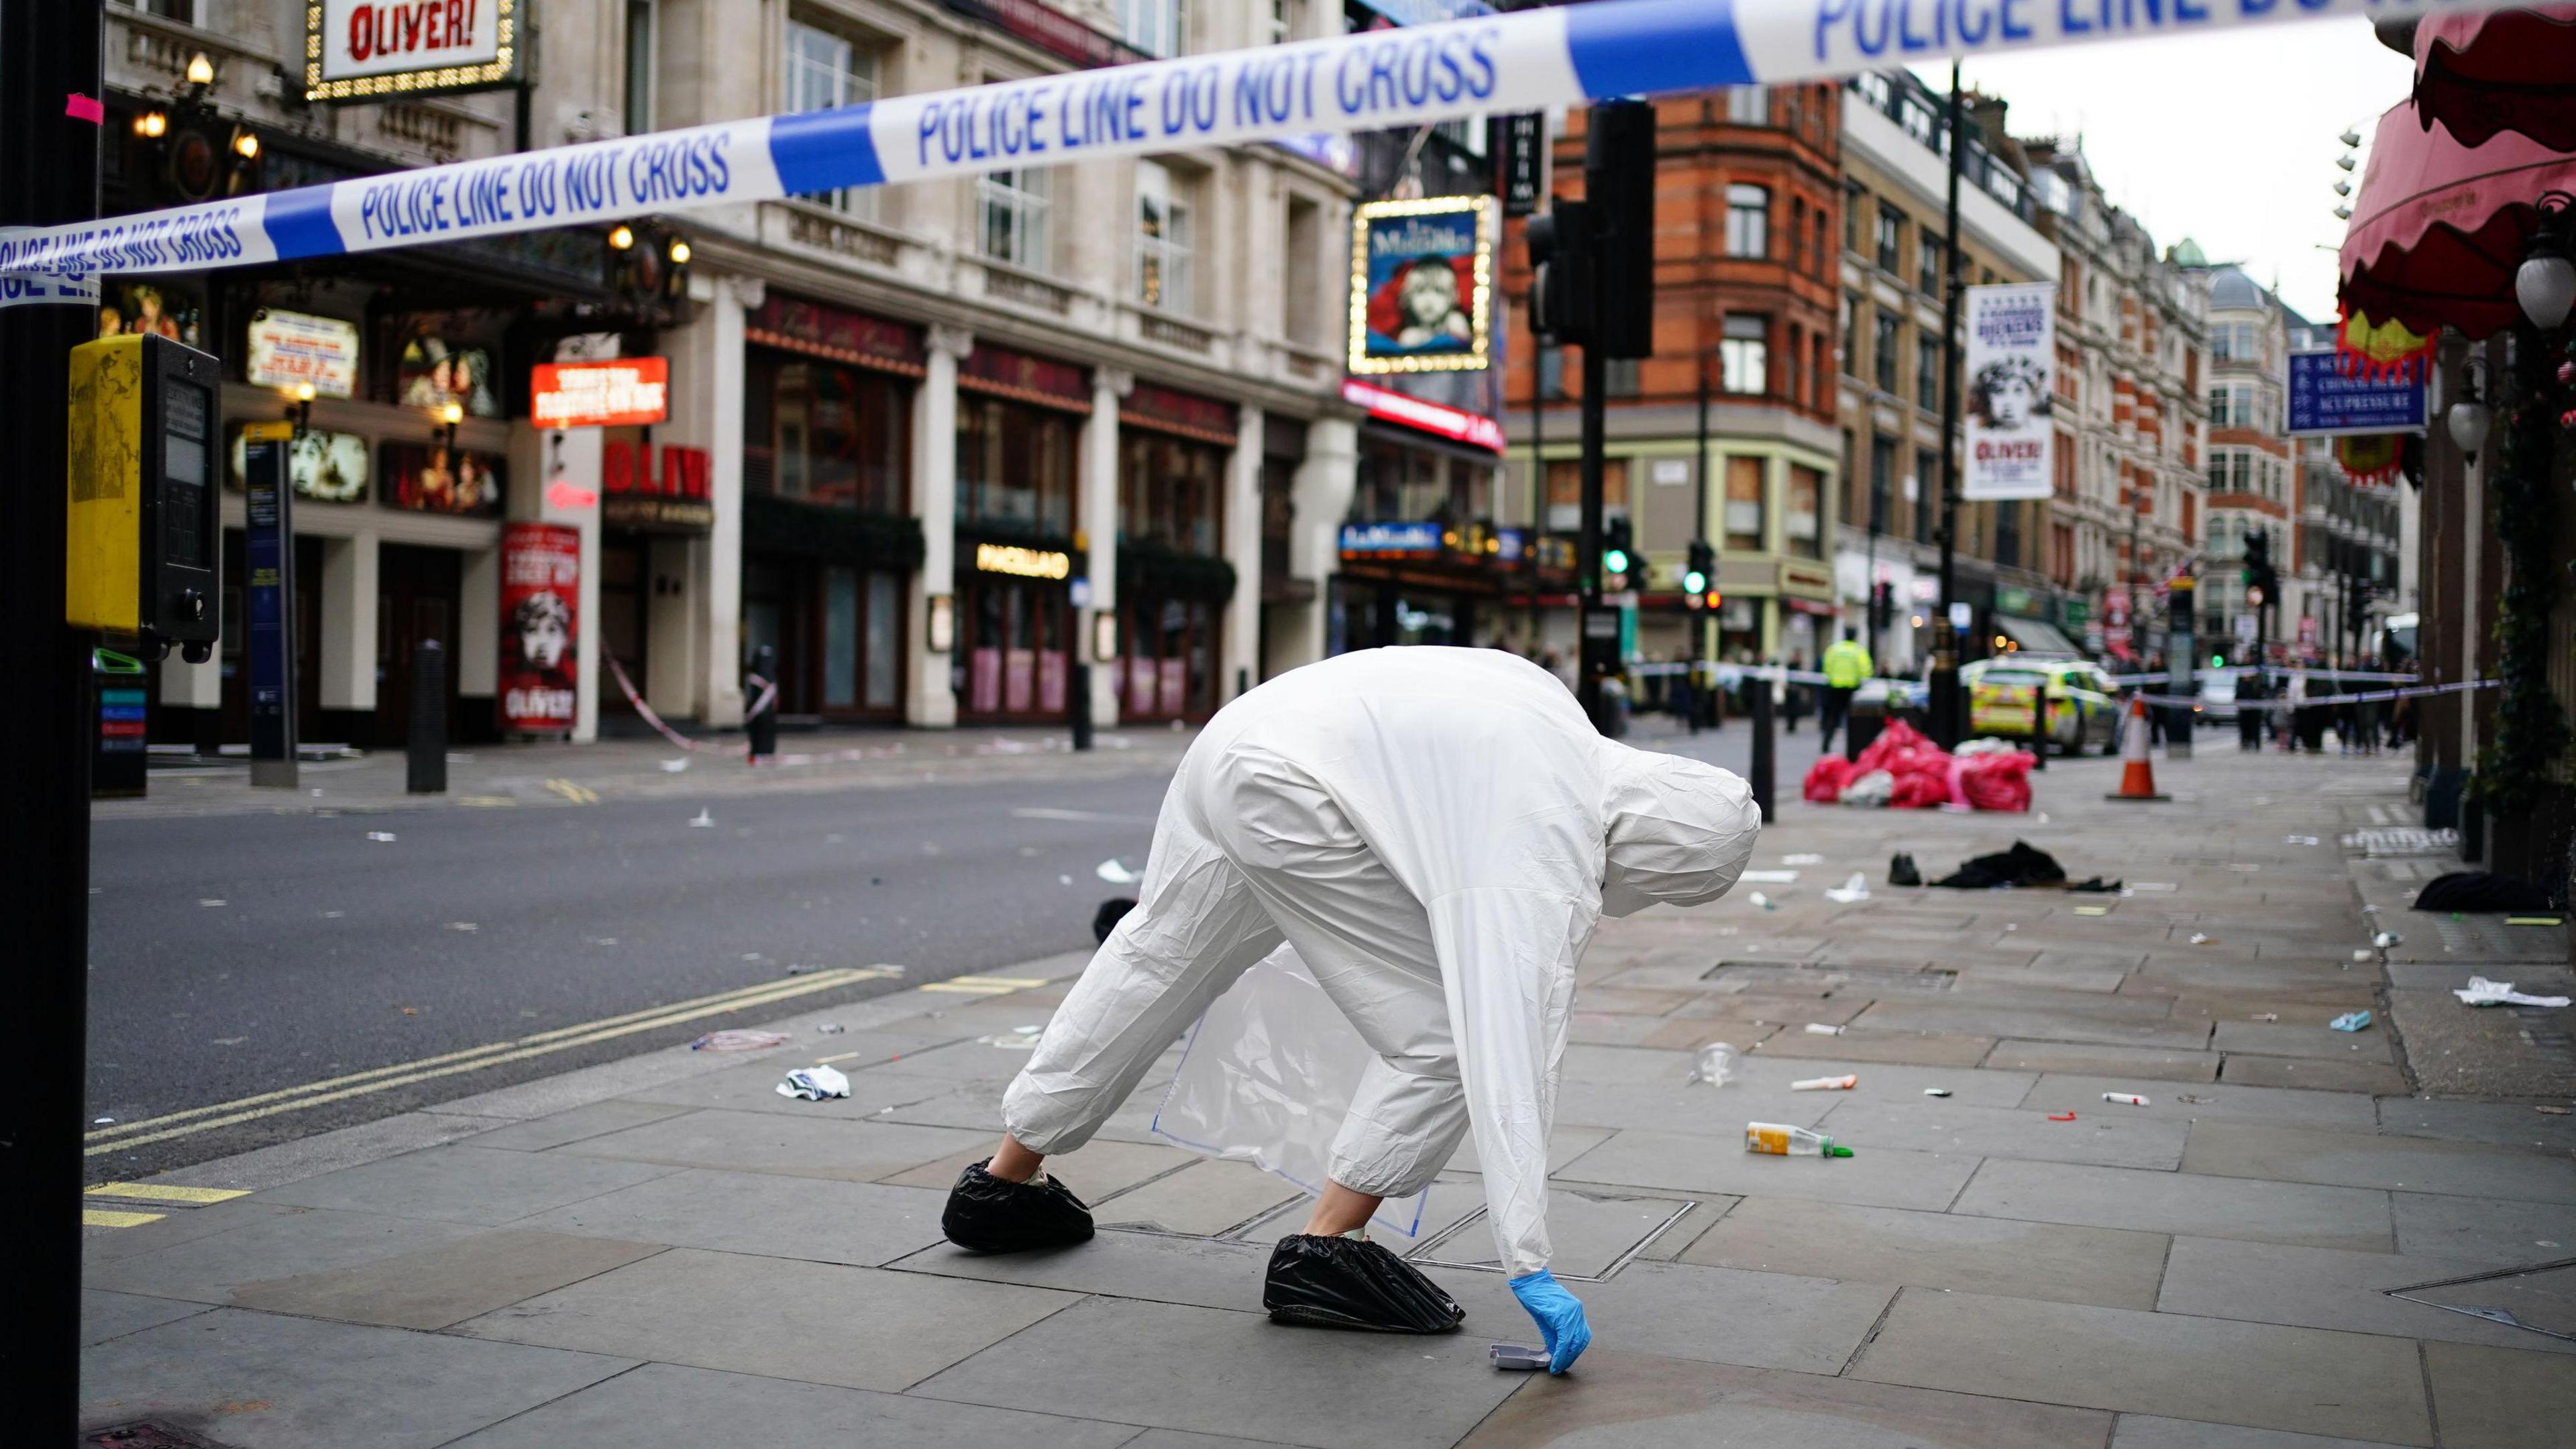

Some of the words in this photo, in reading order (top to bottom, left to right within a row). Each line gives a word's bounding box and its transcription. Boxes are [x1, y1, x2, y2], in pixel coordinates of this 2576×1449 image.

[350, 0, 475, 60] OLIVER!
[918, 84, 1051, 166] POLICE
[1061, 74, 1153, 147] LINE
[1161, 63, 1219, 134] DO
[1235, 48, 1326, 126] NOT
[1337, 26, 1499, 114] CROSS
[362, 174, 449, 239] POLICE
[455, 164, 513, 227] LINE
[519, 158, 556, 218] DO
[564, 148, 625, 213] NOT
[629, 131, 730, 203] CROSS
[0, 237, 51, 271] OLICE
[94, 225, 126, 269] DO
[124, 219, 169, 266] NOT
[169, 207, 241, 262] CROSS
[604, 439, 712, 500] OLIV
